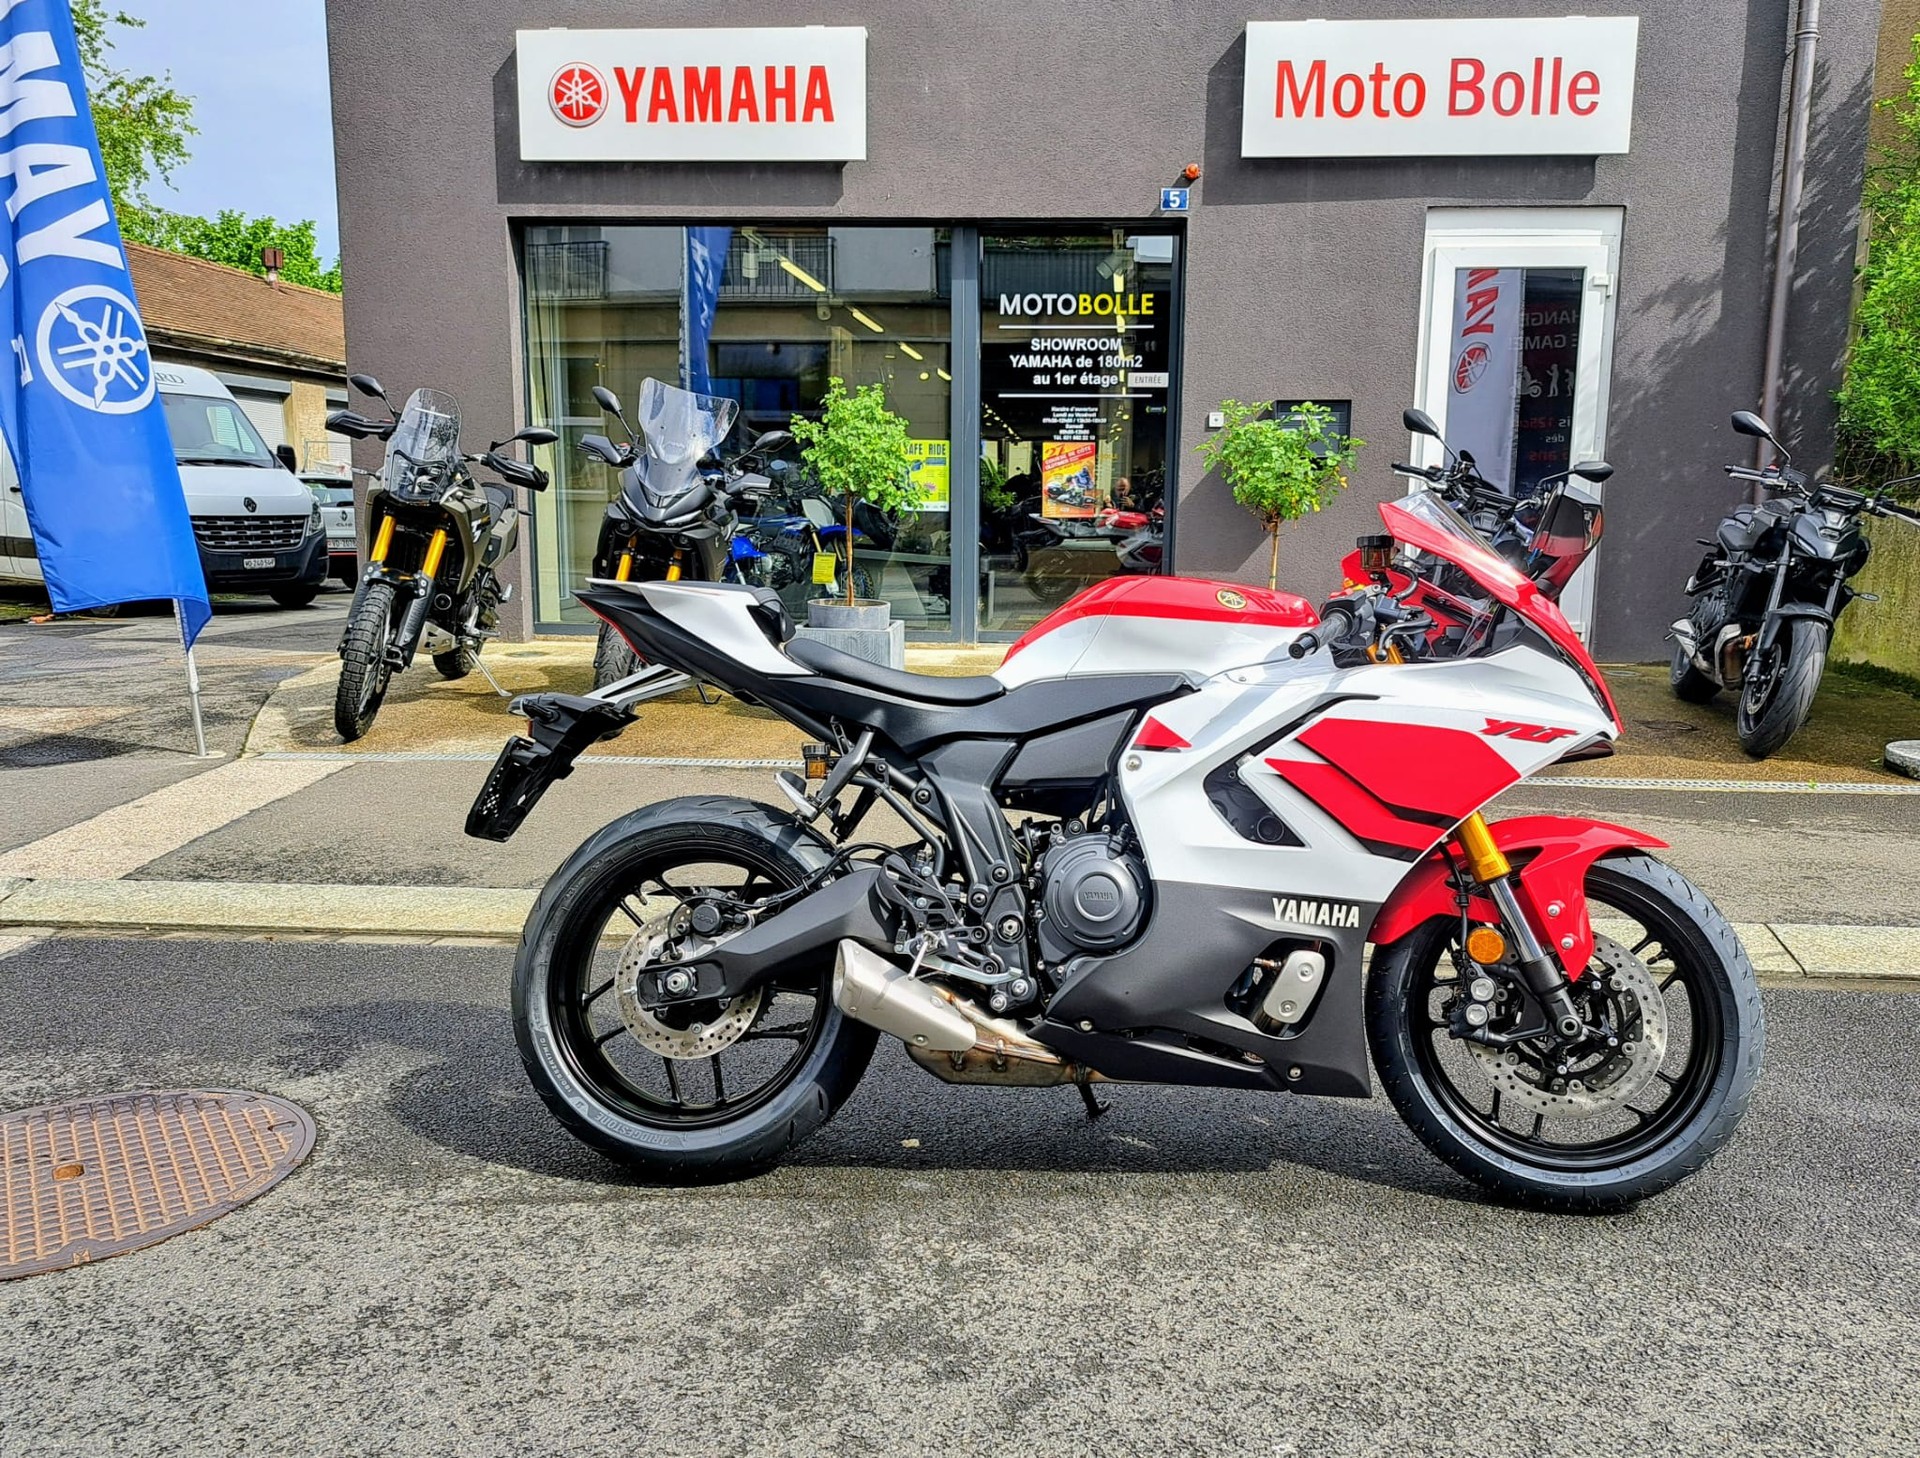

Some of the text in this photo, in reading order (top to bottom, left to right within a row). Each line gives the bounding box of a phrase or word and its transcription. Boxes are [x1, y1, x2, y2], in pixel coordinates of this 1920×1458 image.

[613, 65, 835, 123] YAMAHA
[1274, 57, 1601, 118] Moto Bolle
[1169, 190, 1181, 208] 5
[1000, 293, 1154, 315] MOTOBOLLE
[1030, 338, 1122, 351] SHOWROOM
[1009, 355, 1143, 368] YAMAHA de 180m2
[1033, 371, 1118, 388] au 1er étage
[1134, 375, 1162, 385] ENTRÉE
[928, 443, 946, 455] RIDE
[1272, 897, 1360, 928] YAMAHA
